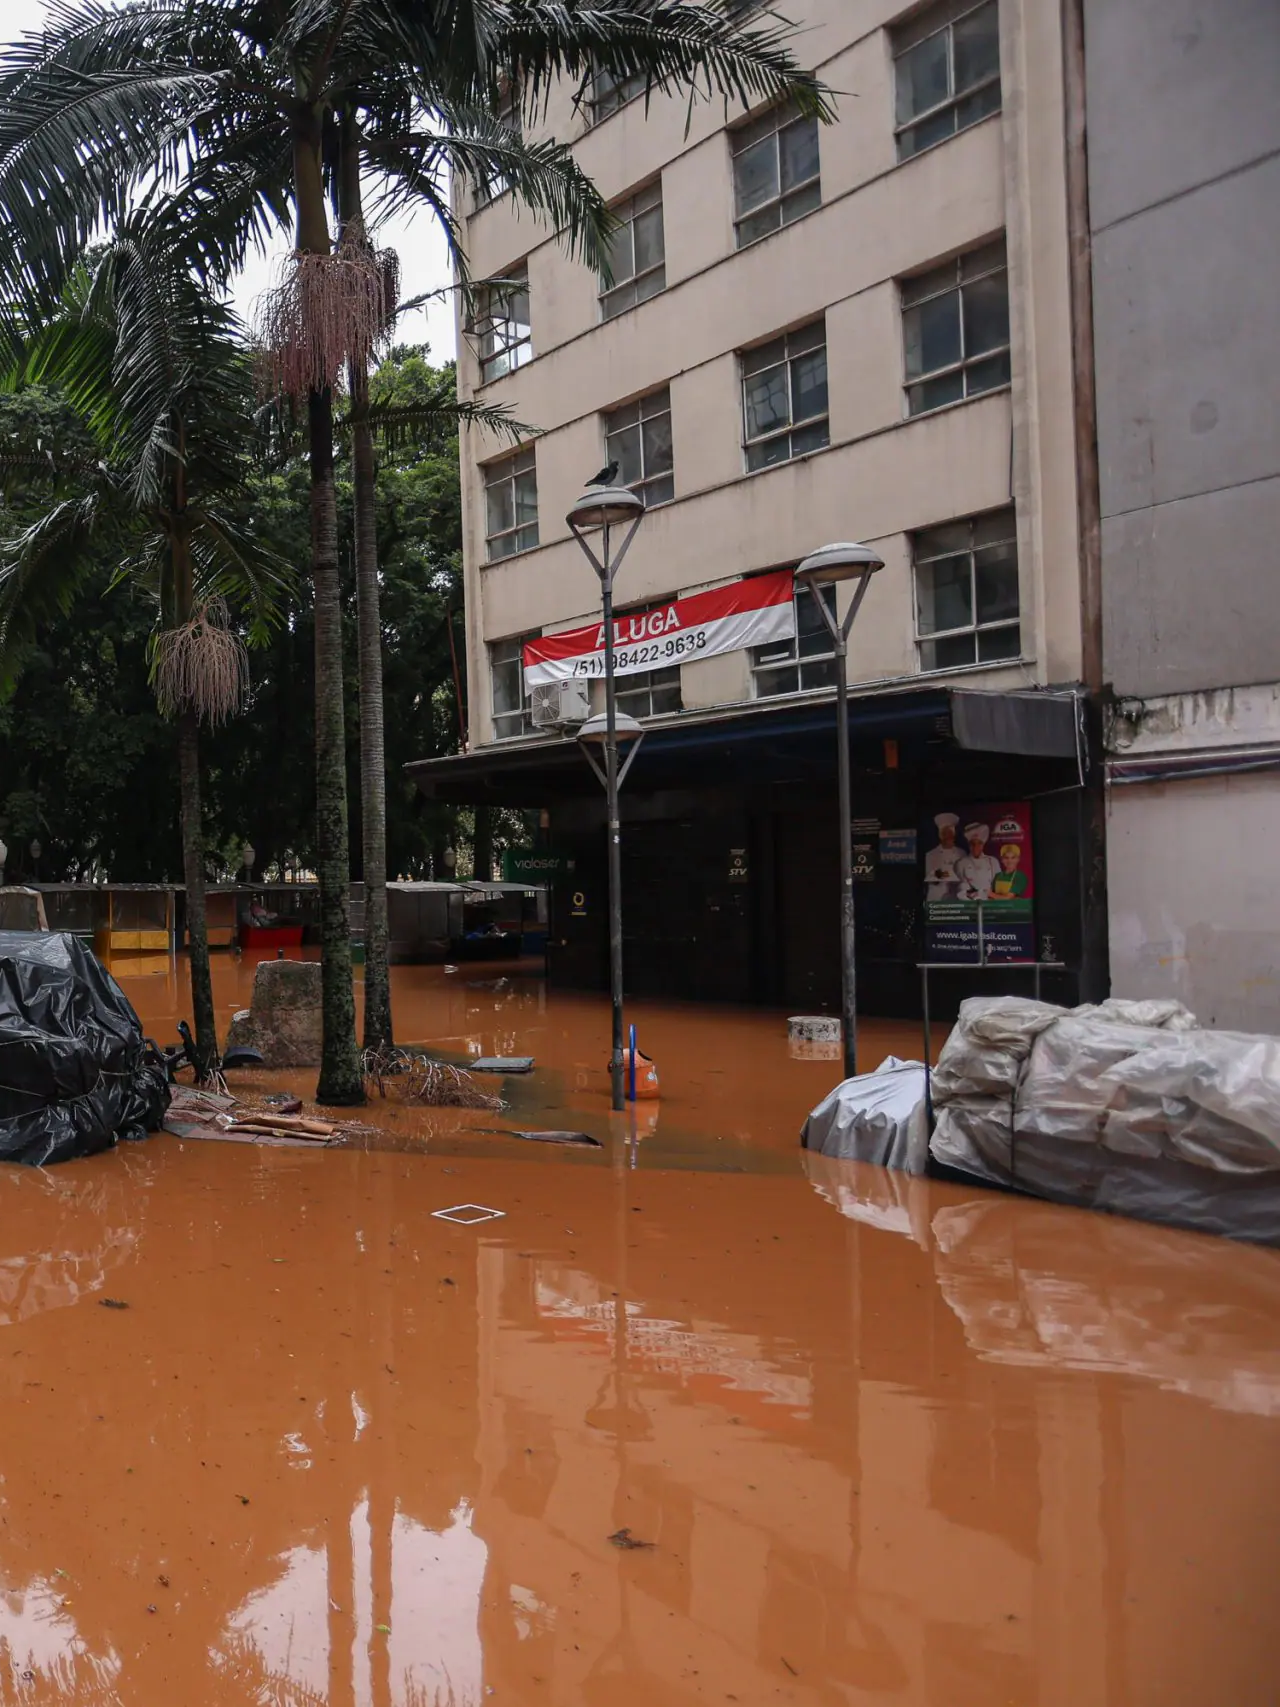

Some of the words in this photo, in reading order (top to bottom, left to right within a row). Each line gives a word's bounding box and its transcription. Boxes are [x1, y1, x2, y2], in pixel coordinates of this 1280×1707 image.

[596, 606, 680, 649] ALUGA
[573, 657, 603, 676] (51)
[611, 631, 707, 669] 98422-9638
[1000, 823, 1016, 831] IGA
[514, 857, 560, 869] vialaser
[728, 868, 747, 876] STV
[852, 865, 874, 874] STV
[936, 930, 1017, 942] www.igabasil.com
